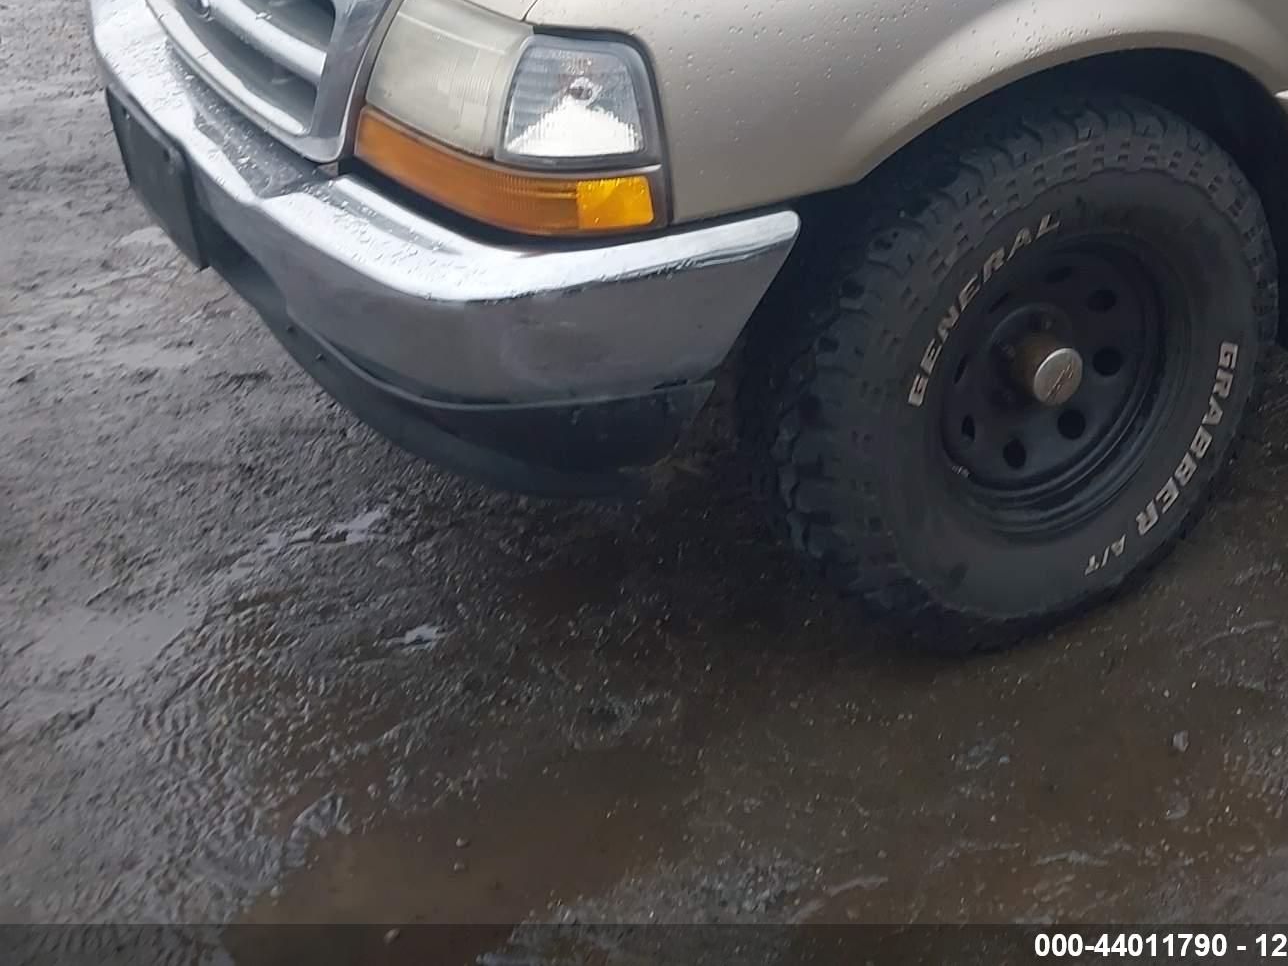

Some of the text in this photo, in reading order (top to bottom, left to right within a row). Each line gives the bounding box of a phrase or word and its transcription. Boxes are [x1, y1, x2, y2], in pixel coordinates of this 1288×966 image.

[908, 214, 1060, 407] GENERAL
[1084, 341, 1239, 576] GRABBER A/T
